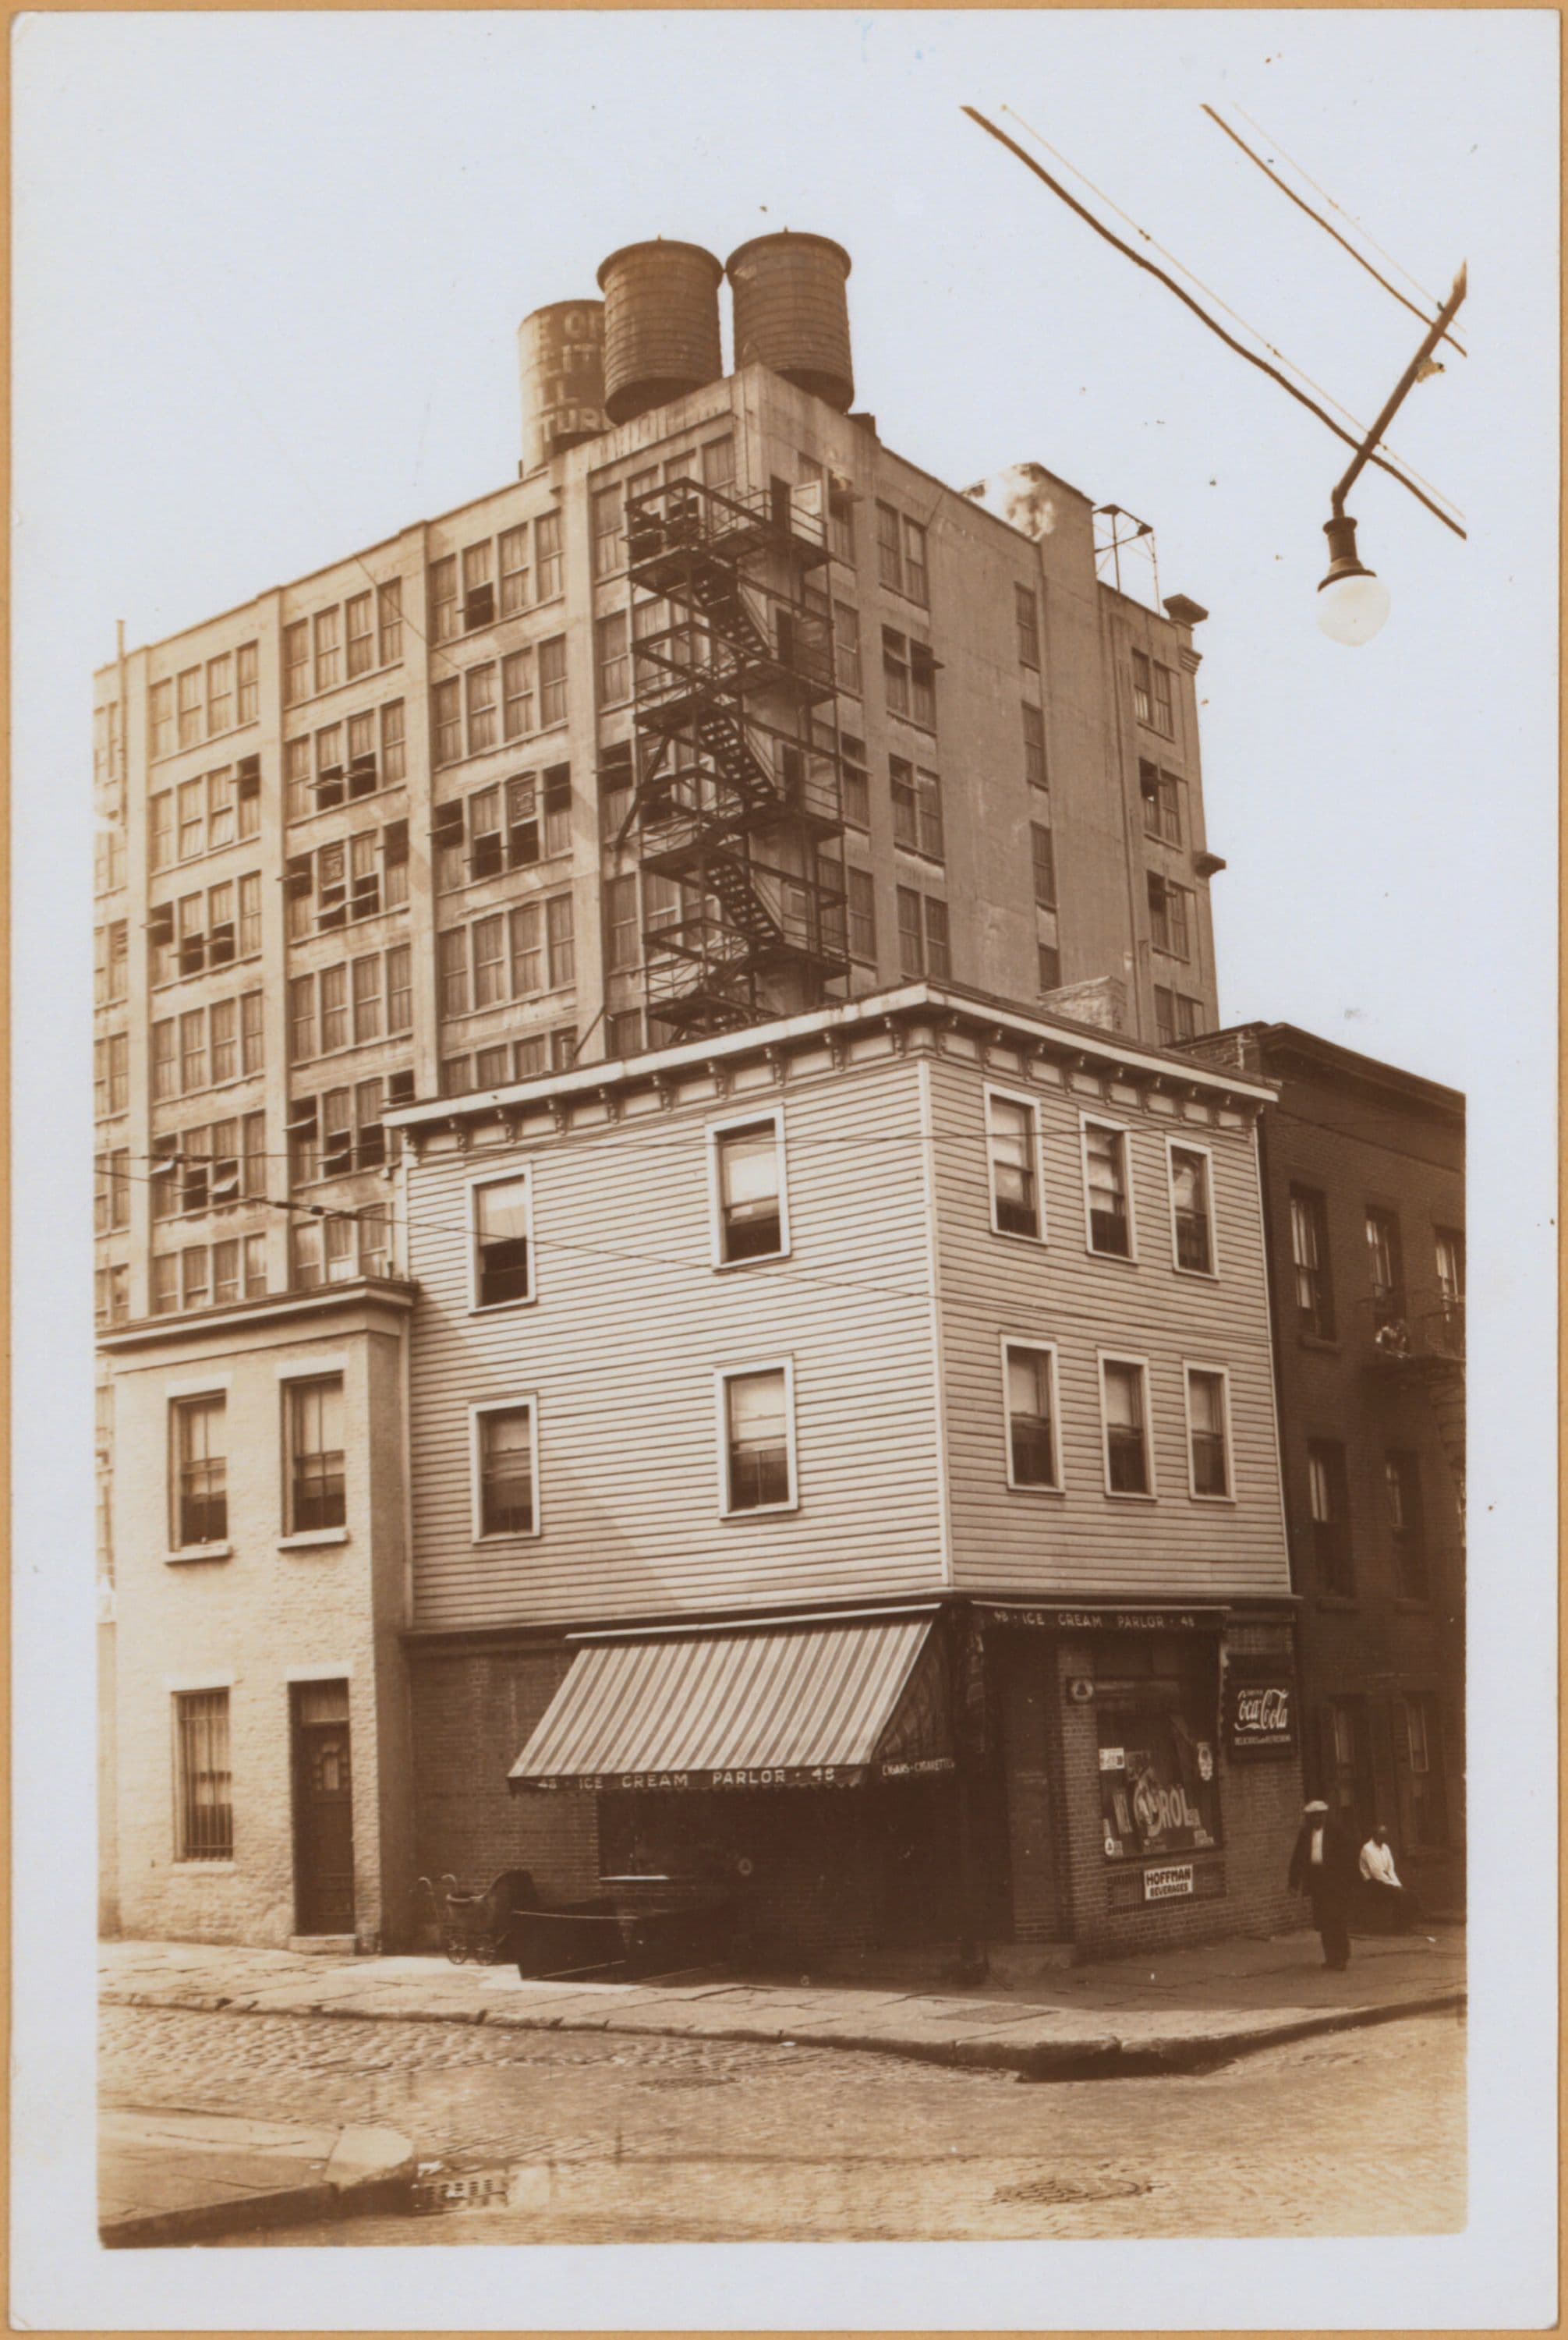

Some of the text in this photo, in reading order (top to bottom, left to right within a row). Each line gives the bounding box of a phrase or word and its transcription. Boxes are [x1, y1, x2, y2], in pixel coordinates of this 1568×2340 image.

[1022, 1612, 1045, 1626] ICE
[1058, 1613, 1103, 1628] CREAM
[1117, 1614, 1166, 1628] PARLOR
[1234, 1688, 1290, 1731] Coca-Cola
[579, 1776, 604, 1790] ICE
[621, 1772, 688, 1789] CREAM
[713, 1768, 786, 1785] PARLOR
[1147, 1869, 1191, 1886] HOFFMAN
[1150, 1882, 1188, 1897] BEVERAGES
